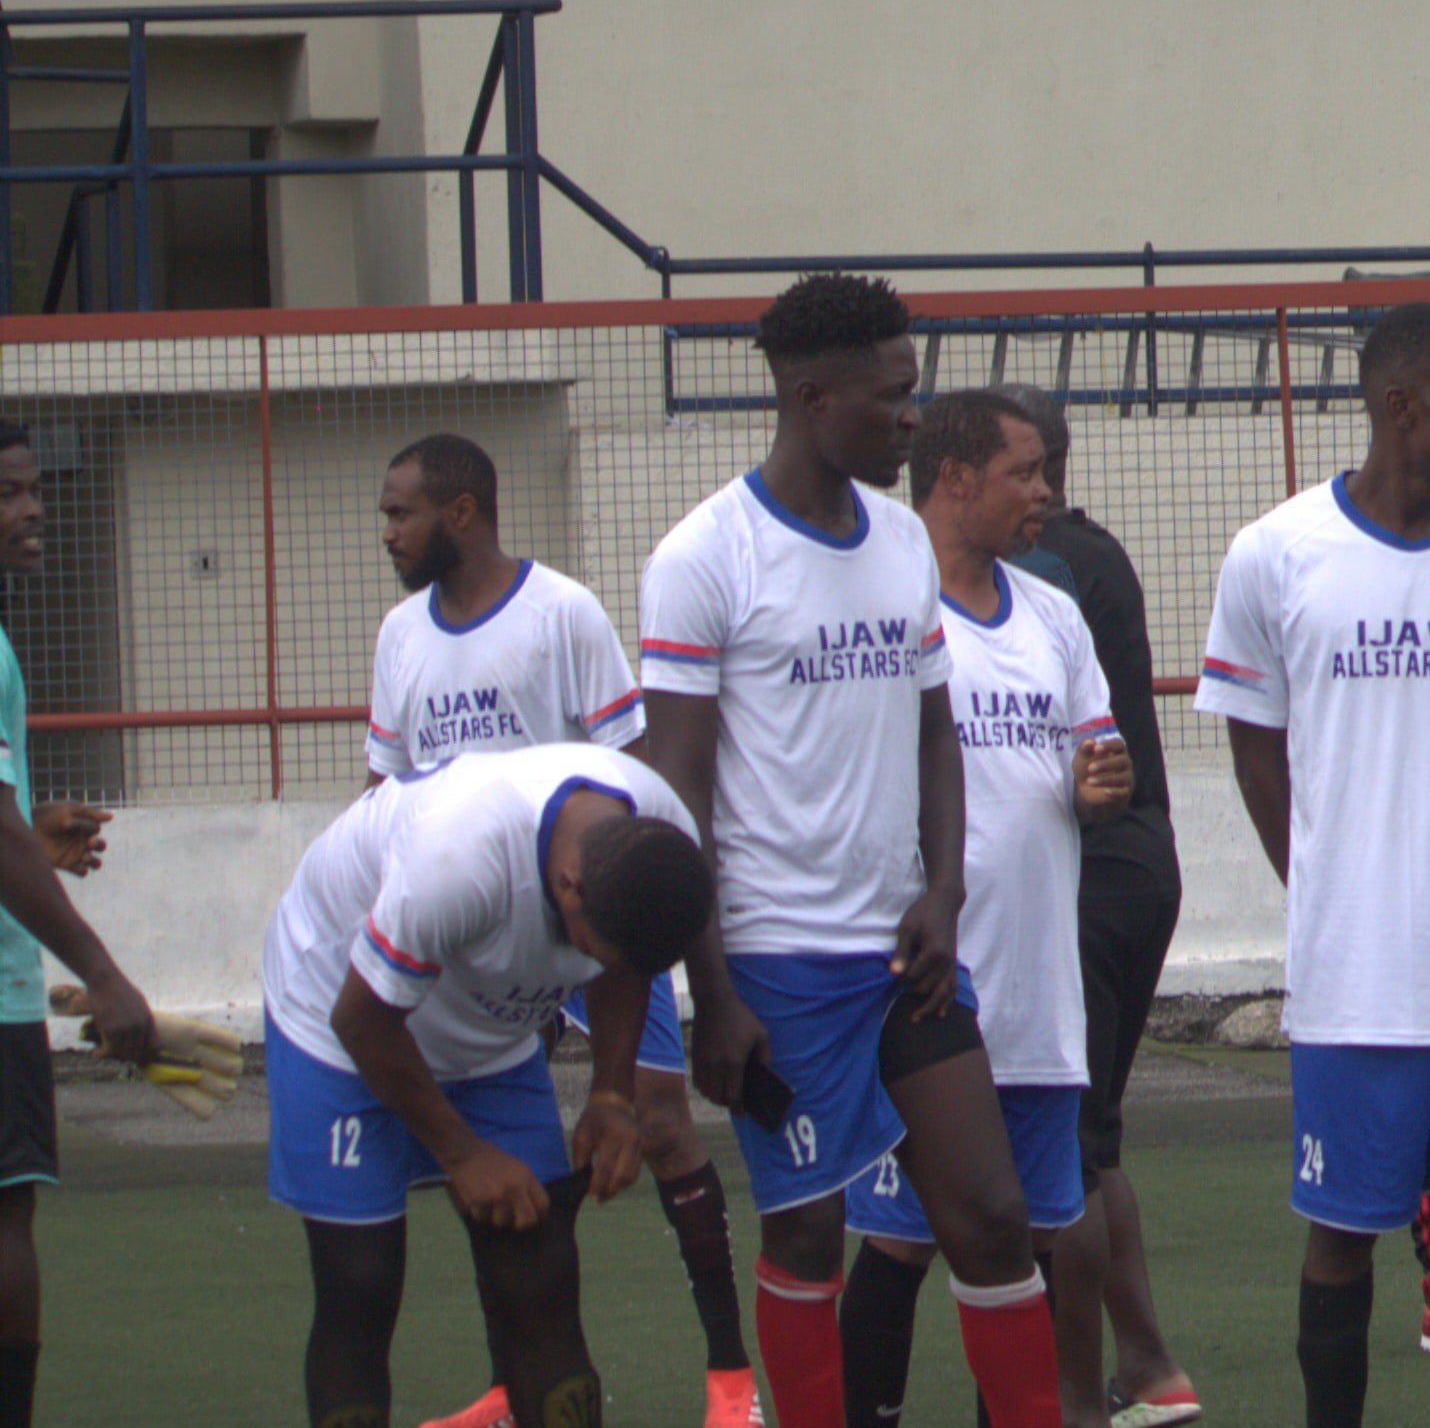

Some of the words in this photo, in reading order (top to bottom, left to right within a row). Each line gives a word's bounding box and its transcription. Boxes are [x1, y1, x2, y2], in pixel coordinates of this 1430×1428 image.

[818, 618, 906, 652] IJAW
[789, 652, 900, 685] ALLSTARS
[904, 648, 920, 677] FC
[427, 688, 498, 719] IJAW
[972, 691, 1052, 718] IJAW
[418, 715, 494, 752] ALLSTARS
[499, 713, 523, 738] FC
[956, 722, 1046, 750] ALLSTARS
[1049, 725, 1070, 752] FC
[330, 1116, 361, 1168] 12
[785, 1115, 817, 1167] 19
[1300, 1133, 1324, 1186] 24
[873, 1152, 900, 1198] 23
